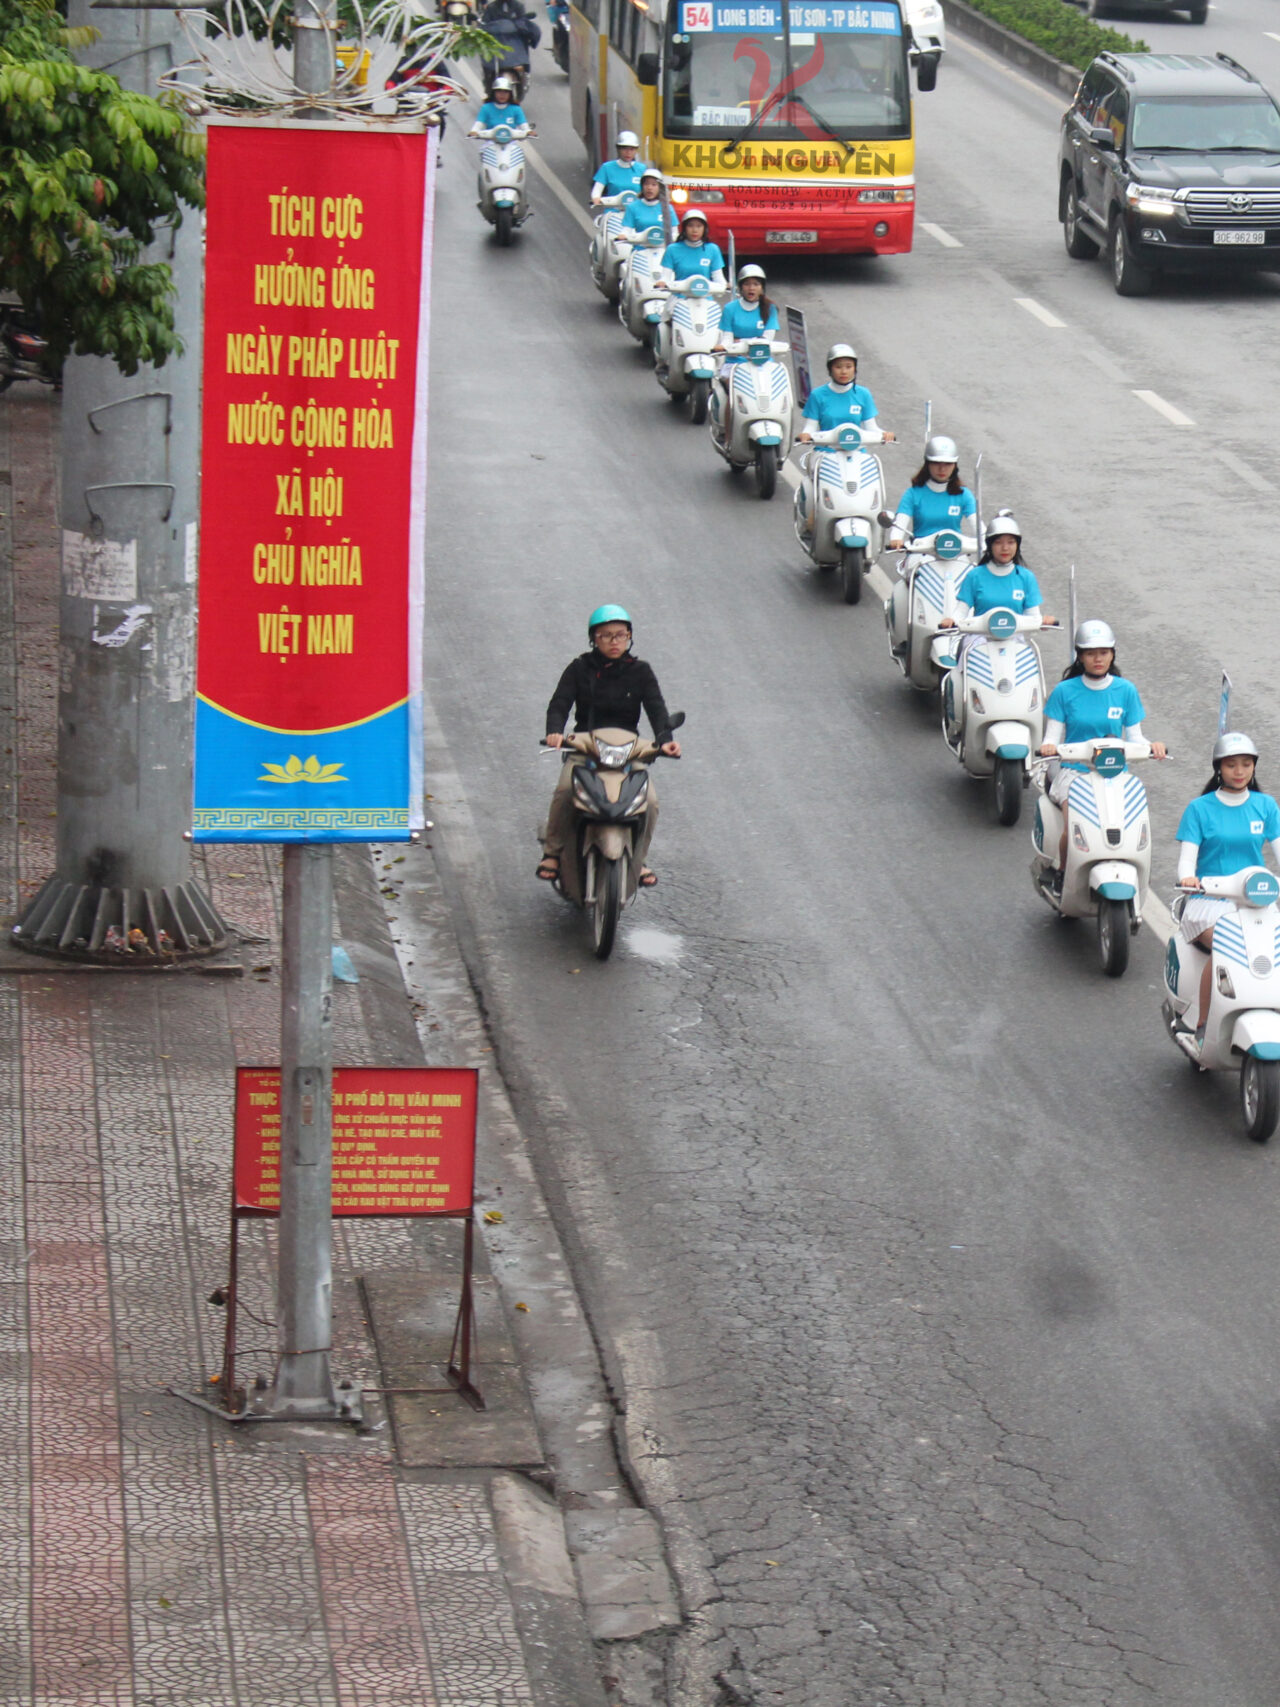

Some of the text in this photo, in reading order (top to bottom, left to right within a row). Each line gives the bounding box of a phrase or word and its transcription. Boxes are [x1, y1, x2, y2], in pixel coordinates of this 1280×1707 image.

[686, 7, 710, 26] 54
[718, 9, 747, 26] LONG
[871, 11, 895, 29] NINH
[269, 186, 363, 248] TÍCH CỰC
[254, 248, 375, 309] HƯỞNG ỨNG
[226, 326, 400, 389] NGÀY PHÁP LUẬT
[228, 392, 393, 457] NƯỚC CỘNG HÒA
[275, 468, 343, 526] XÃ HỘI
[253, 527, 295, 585] CHỦ
[300, 538, 363, 586] NGHĨA
[258, 605, 354, 663] VIỆT NAM
